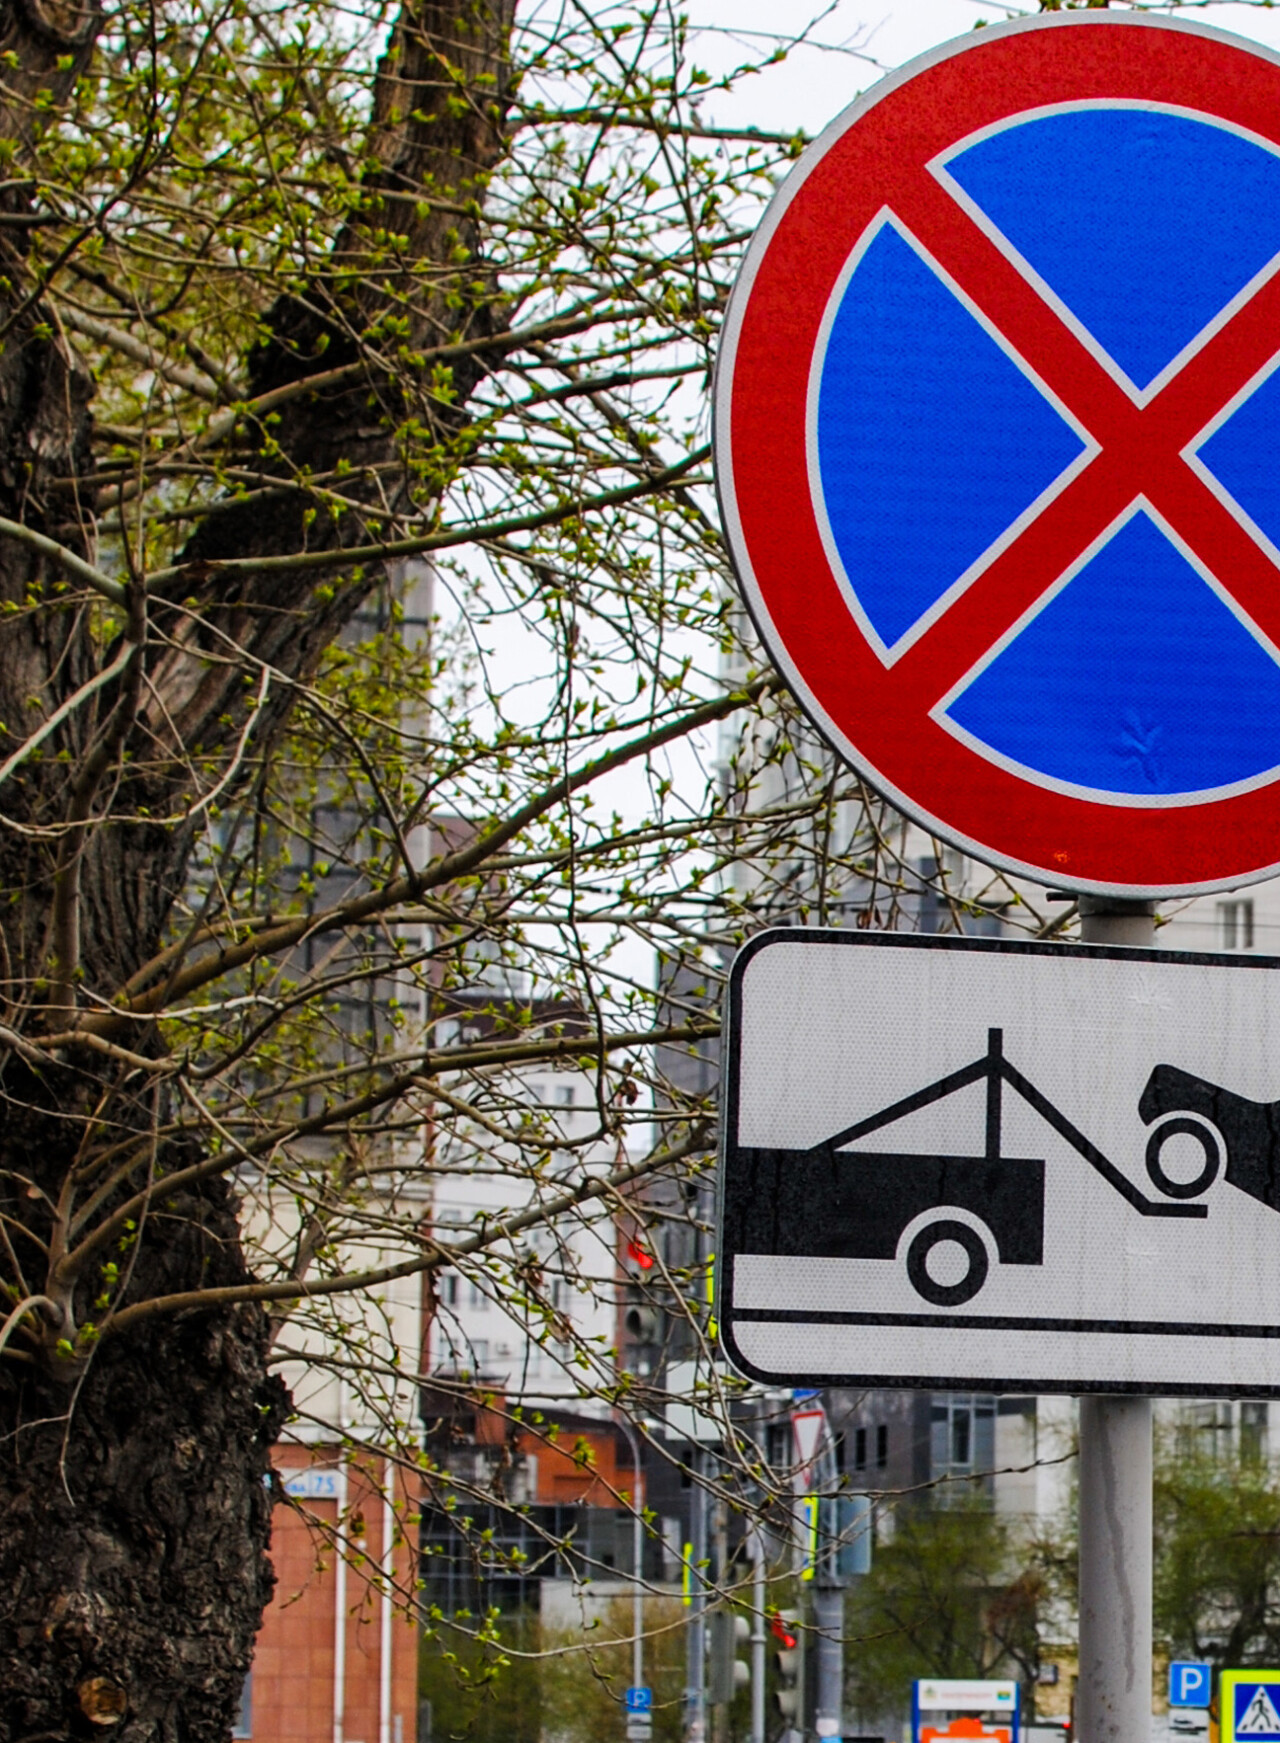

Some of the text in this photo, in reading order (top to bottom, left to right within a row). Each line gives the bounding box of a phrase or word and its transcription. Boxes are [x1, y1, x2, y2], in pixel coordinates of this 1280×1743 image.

[315, 1476, 335, 1494] 75
[1180, 1667, 1203, 1701] P
[633, 1691, 646, 1707] P
